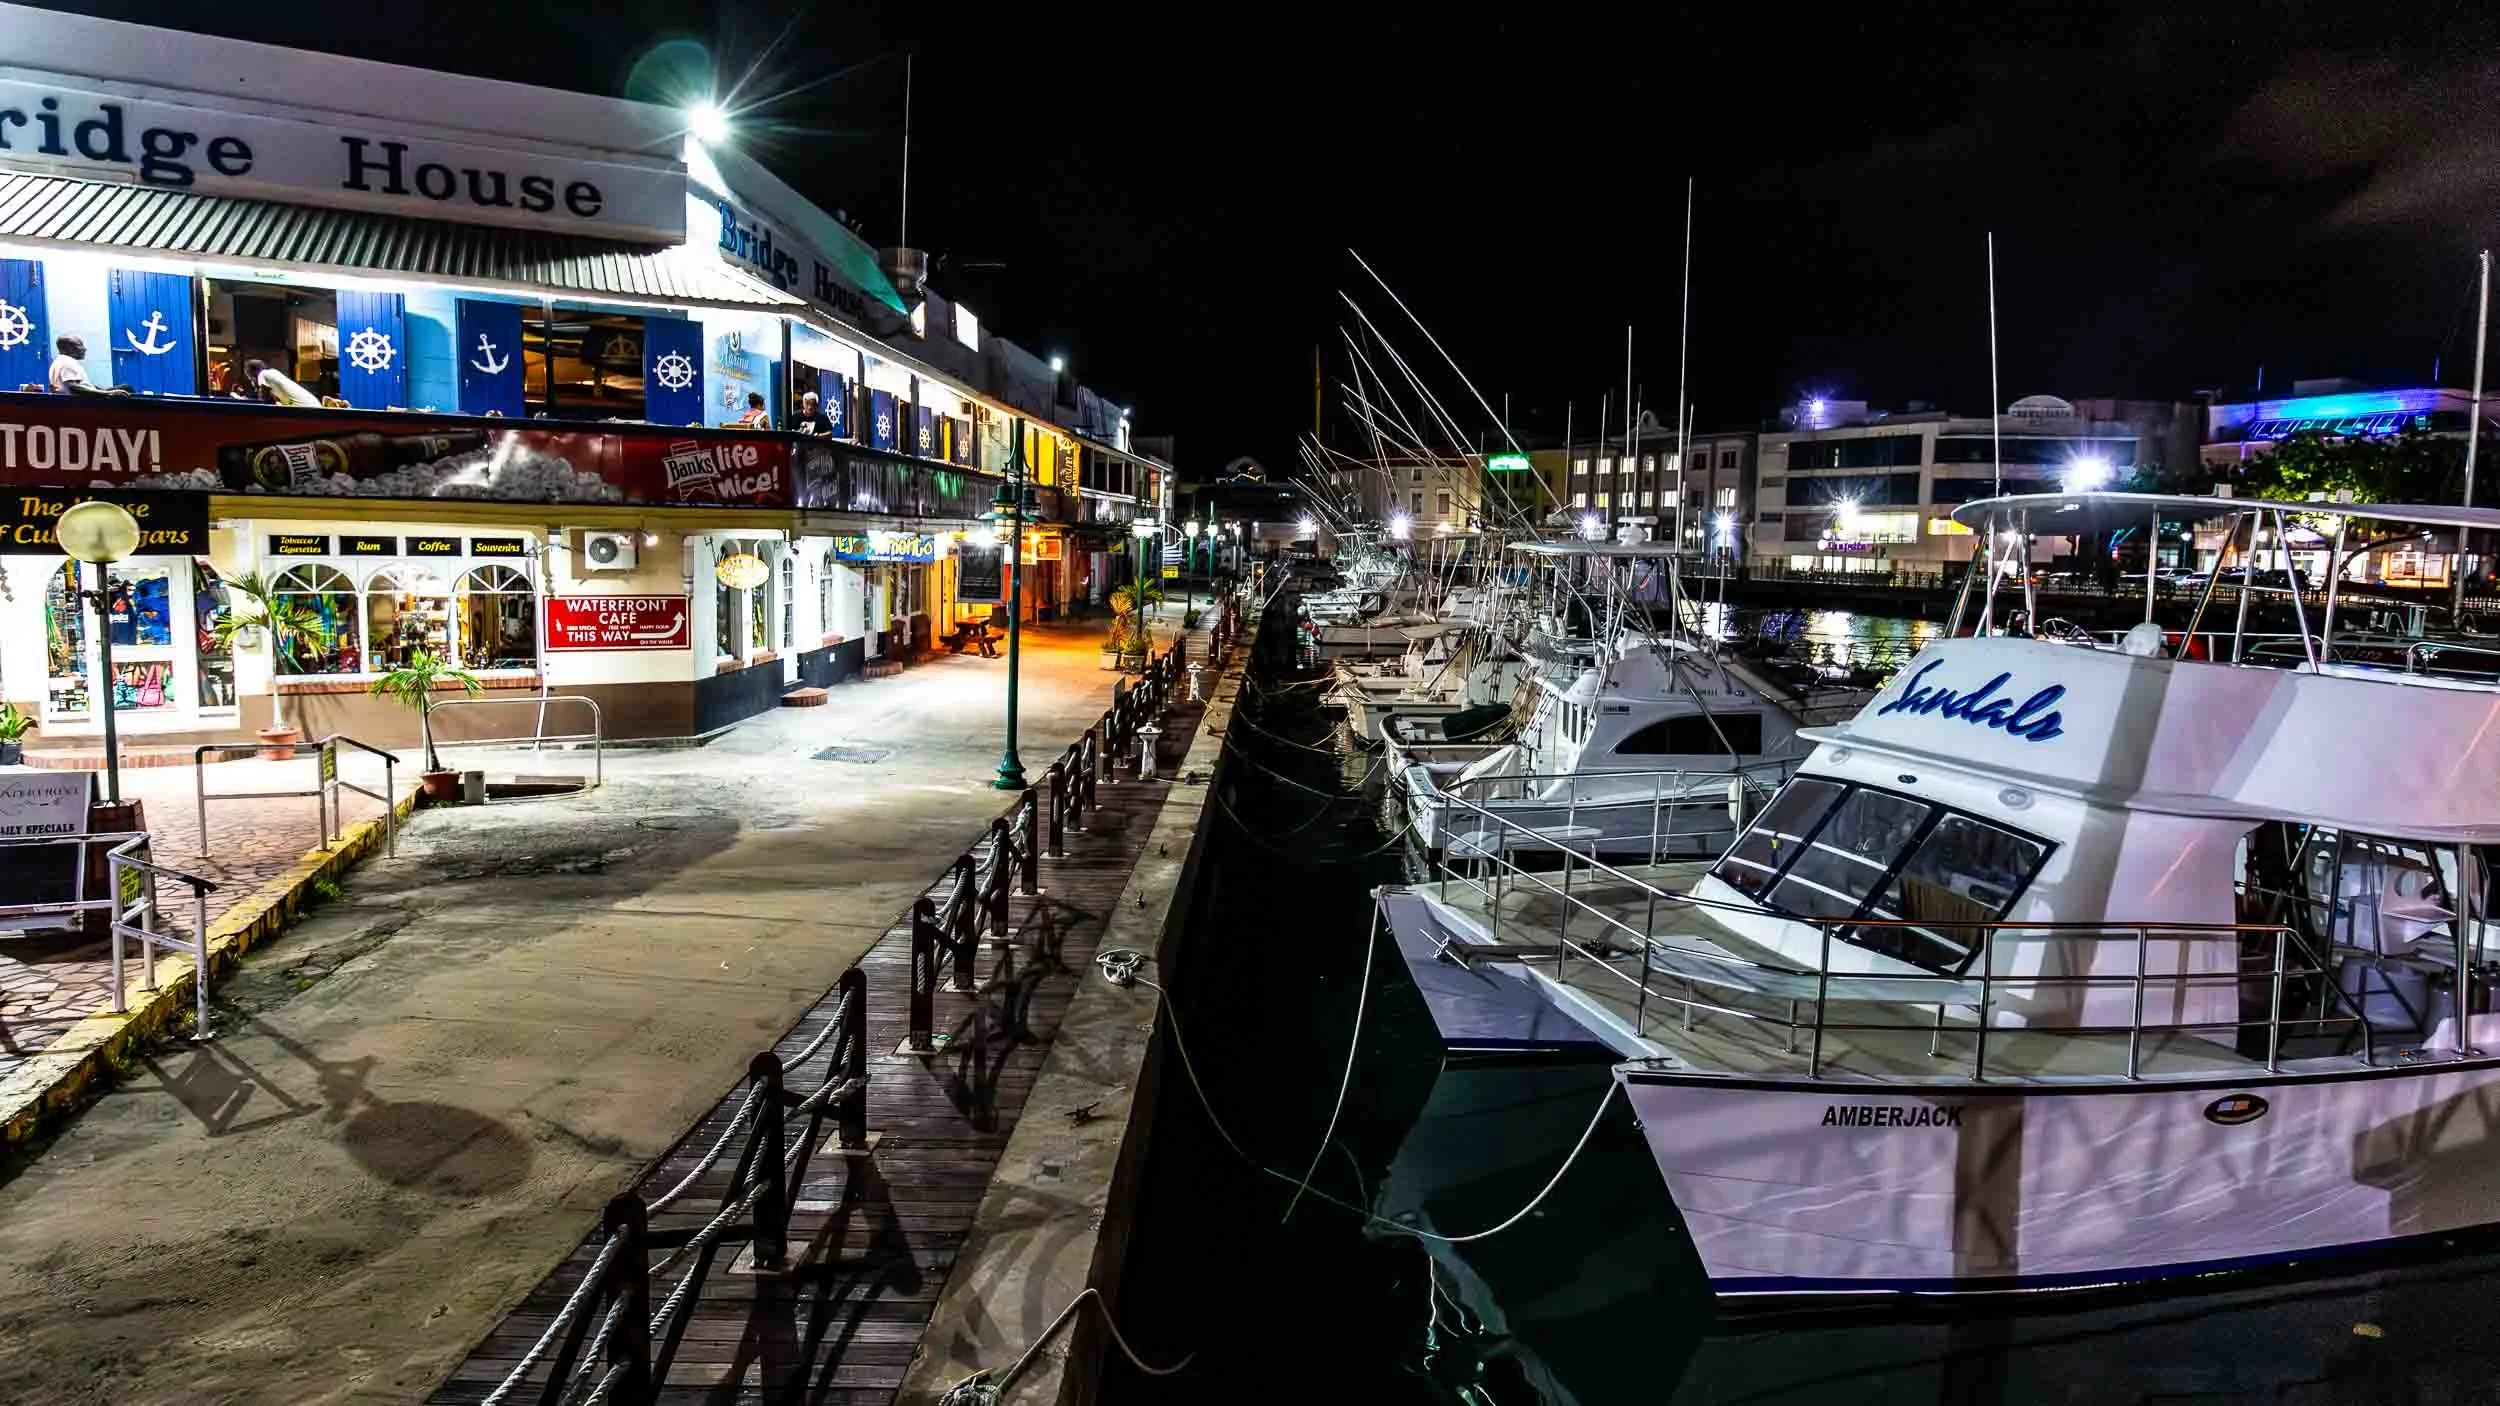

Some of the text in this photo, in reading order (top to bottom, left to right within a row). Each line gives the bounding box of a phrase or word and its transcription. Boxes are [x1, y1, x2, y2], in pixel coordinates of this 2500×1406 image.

[341, 136, 603, 217] House
[718, 200, 799, 291] Bridge
[0, 423, 161, 472] TODAY!
[716, 444, 759, 471] life
[668, 455, 714, 480] Banks
[717, 465, 780, 498] nice!
[19, 496, 64, 517] The
[279, 545, 322, 554] Cigarettes
[280, 536, 313, 545] Tobacco
[356, 541, 381, 552] Rum
[418, 540, 451, 552] Coffee
[475, 543, 521, 553] Souvenirs
[566, 599, 668, 612] WATERFRONT
[566, 630, 630, 642] THIS WAY
[1877, 658, 2067, 742] Sandals
[25, 823, 75, 835] SPECIALS
[1821, 1105, 1965, 1128] AMBERJACK
